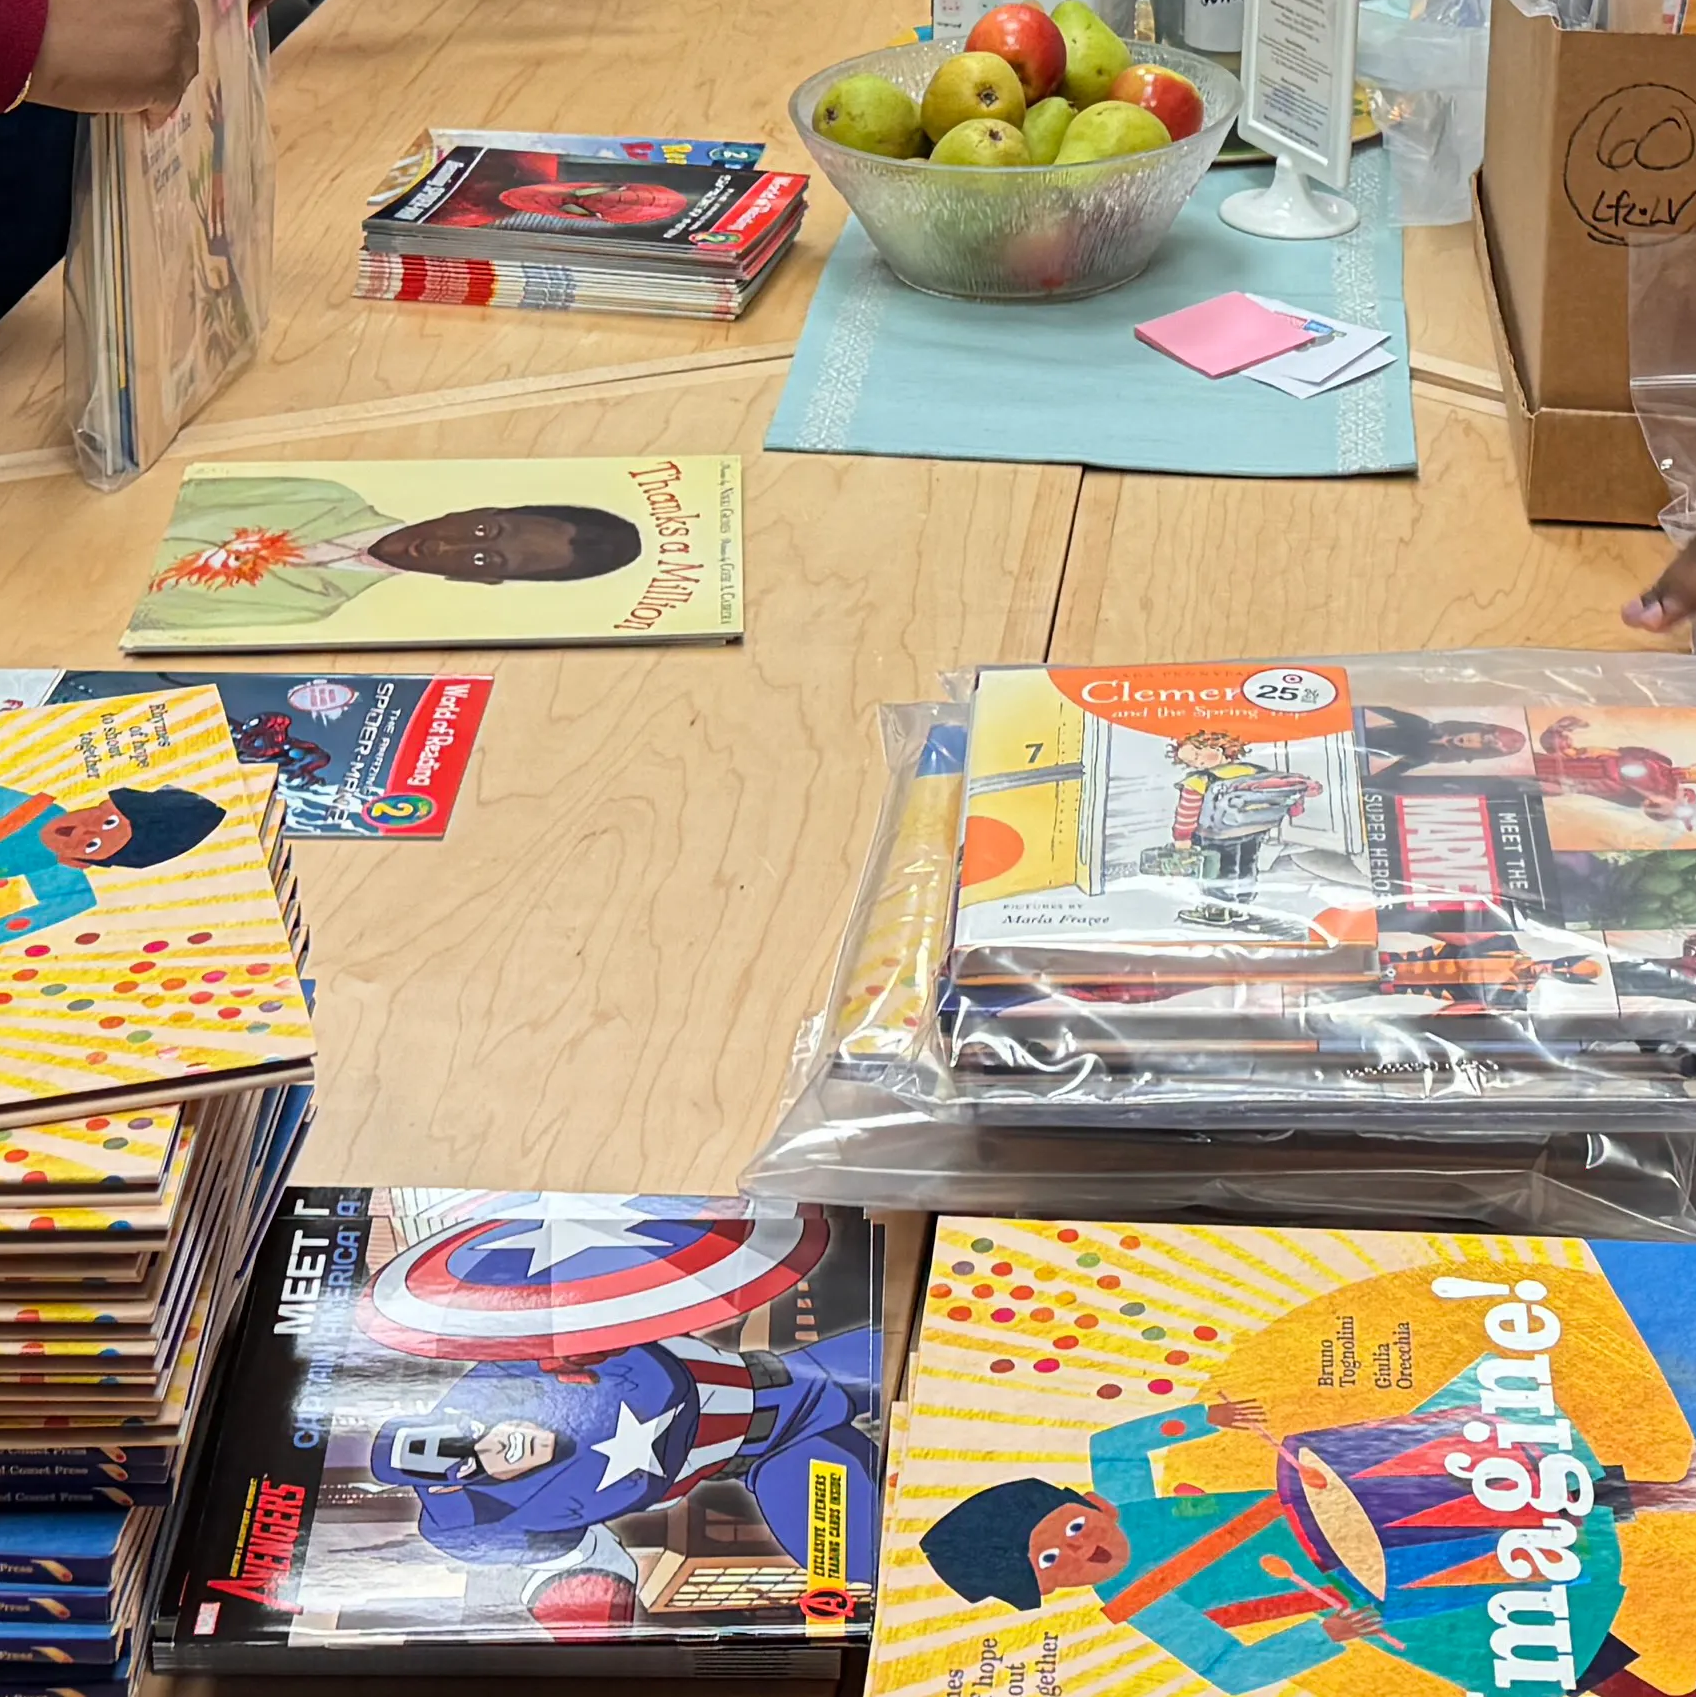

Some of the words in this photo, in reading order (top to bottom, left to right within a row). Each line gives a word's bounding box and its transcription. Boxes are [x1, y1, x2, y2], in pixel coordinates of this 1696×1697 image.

[1596, 106, 1695, 172] 60
[628, 460, 700, 537] Thanks
[659, 541, 690, 555] a
[613, 560, 703, 630] Million
[435, 683, 470, 721] World
[1111, 706, 1148, 718] and
[1157, 705, 1186, 717] the
[1193, 705, 1259, 720] Spring
[1255, 685, 1299, 701] 25
[100, 712, 119, 725] to
[129, 725, 148, 738] of
[147, 703, 171, 747] Rhymes
[429, 718, 454, 735] of
[74, 731, 102, 779] together
[104, 726, 124, 759] shout
[129, 738, 150, 768] hope
[407, 734, 454, 786] Reading
[1024, 742, 1045, 764] 7
[372, 802, 414, 818] 2
[1364, 794, 1386, 842] SUPER
[1498, 812, 1522, 853] MEET
[1506, 859, 1529, 891] THE
[1002, 914, 1053, 925] Marla
[274, 1229, 330, 1334] MEET
[1318, 1338, 1335, 1389] Bruno
[1339, 1314, 1361, 1389] Tognolini
[1375, 1343, 1392, 1390] Giulia
[1396, 1320, 1414, 1390] Orecchia
[1433, 1275, 1594, 1697] magine!
[0, 1562, 34, 1574] Press
[208, 1479, 306, 1614] AVENGERS
[981, 1637, 1004, 1688] hope
[1038, 1631, 1064, 1697] gether
